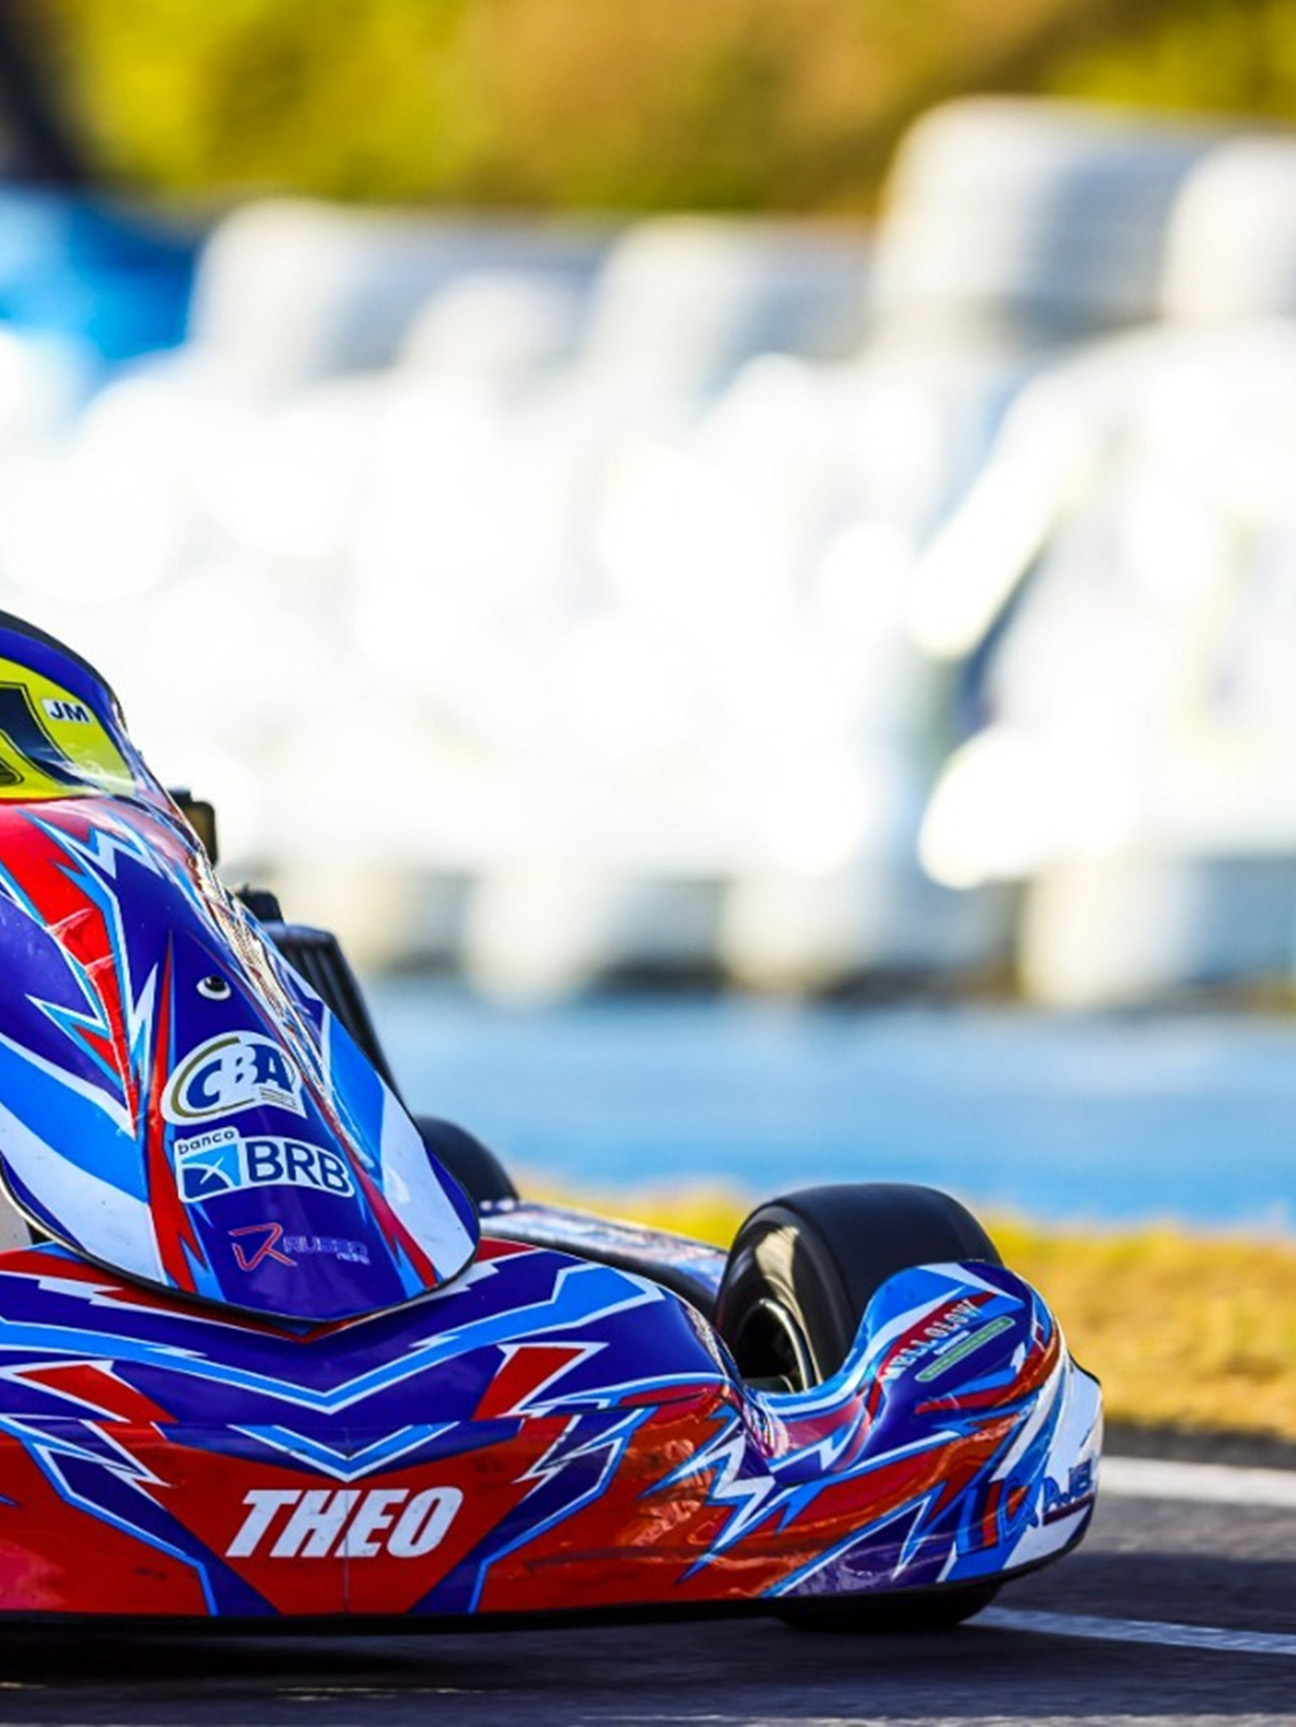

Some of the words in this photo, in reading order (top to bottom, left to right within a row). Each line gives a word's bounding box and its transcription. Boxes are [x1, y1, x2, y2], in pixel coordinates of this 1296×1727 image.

[49, 701, 89, 723] JM
[186, 1043, 294, 1110] CBA
[177, 1130, 235, 1155] banco
[245, 1141, 350, 1193] BRB
[225, 1486, 464, 1558] THEO
